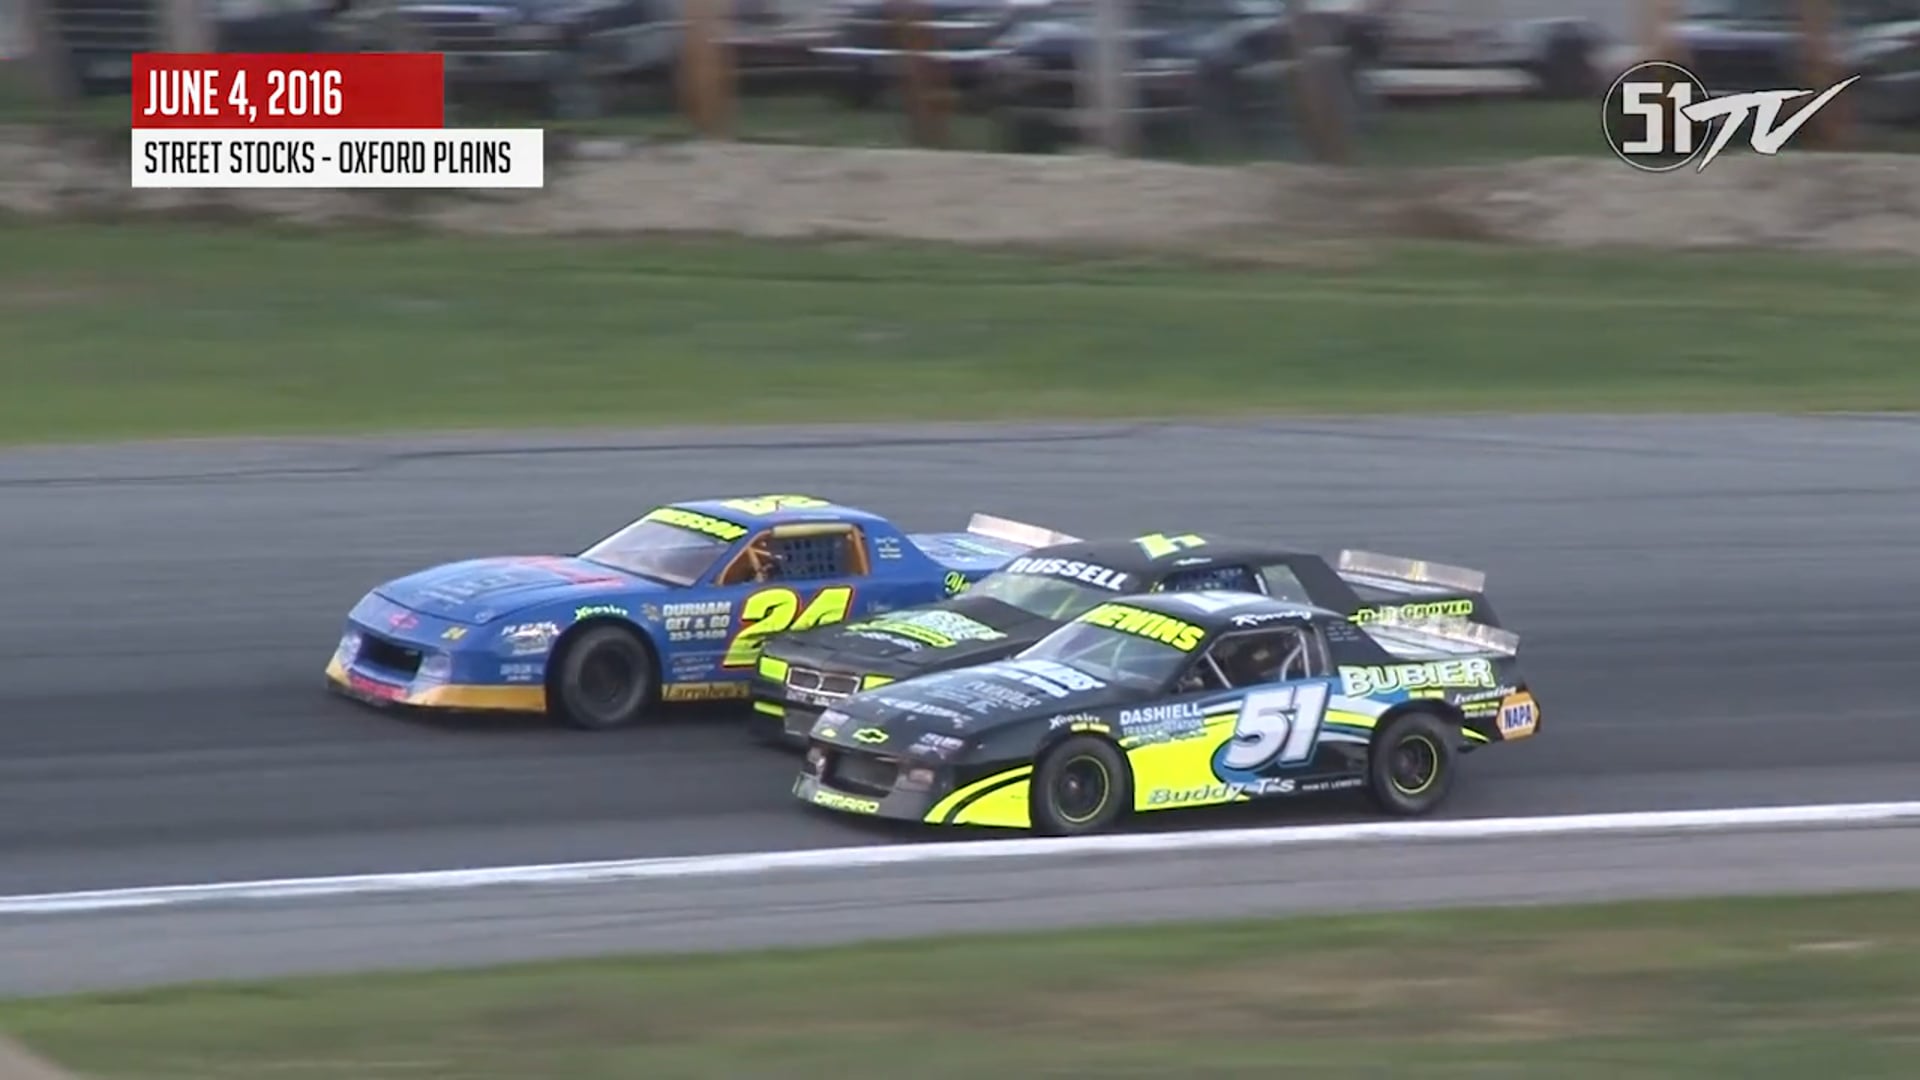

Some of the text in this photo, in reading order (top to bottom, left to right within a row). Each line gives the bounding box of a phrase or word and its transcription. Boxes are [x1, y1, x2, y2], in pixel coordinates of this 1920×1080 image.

[1007, 557, 1129, 592] RUSSELL
[663, 602, 731, 616] DURHAM
[1403, 600, 1473, 618] GROVER
[665, 616, 690, 630] GET
[710, 615, 730, 629] GO
[1338, 658, 1496, 698] BUBIER
[1120, 702, 1203, 726] DASHIELL
[1224, 682, 1331, 770] 51
[1505, 704, 1532, 729] NAPA
[1147, 777, 1296, 806] Buddy T's
